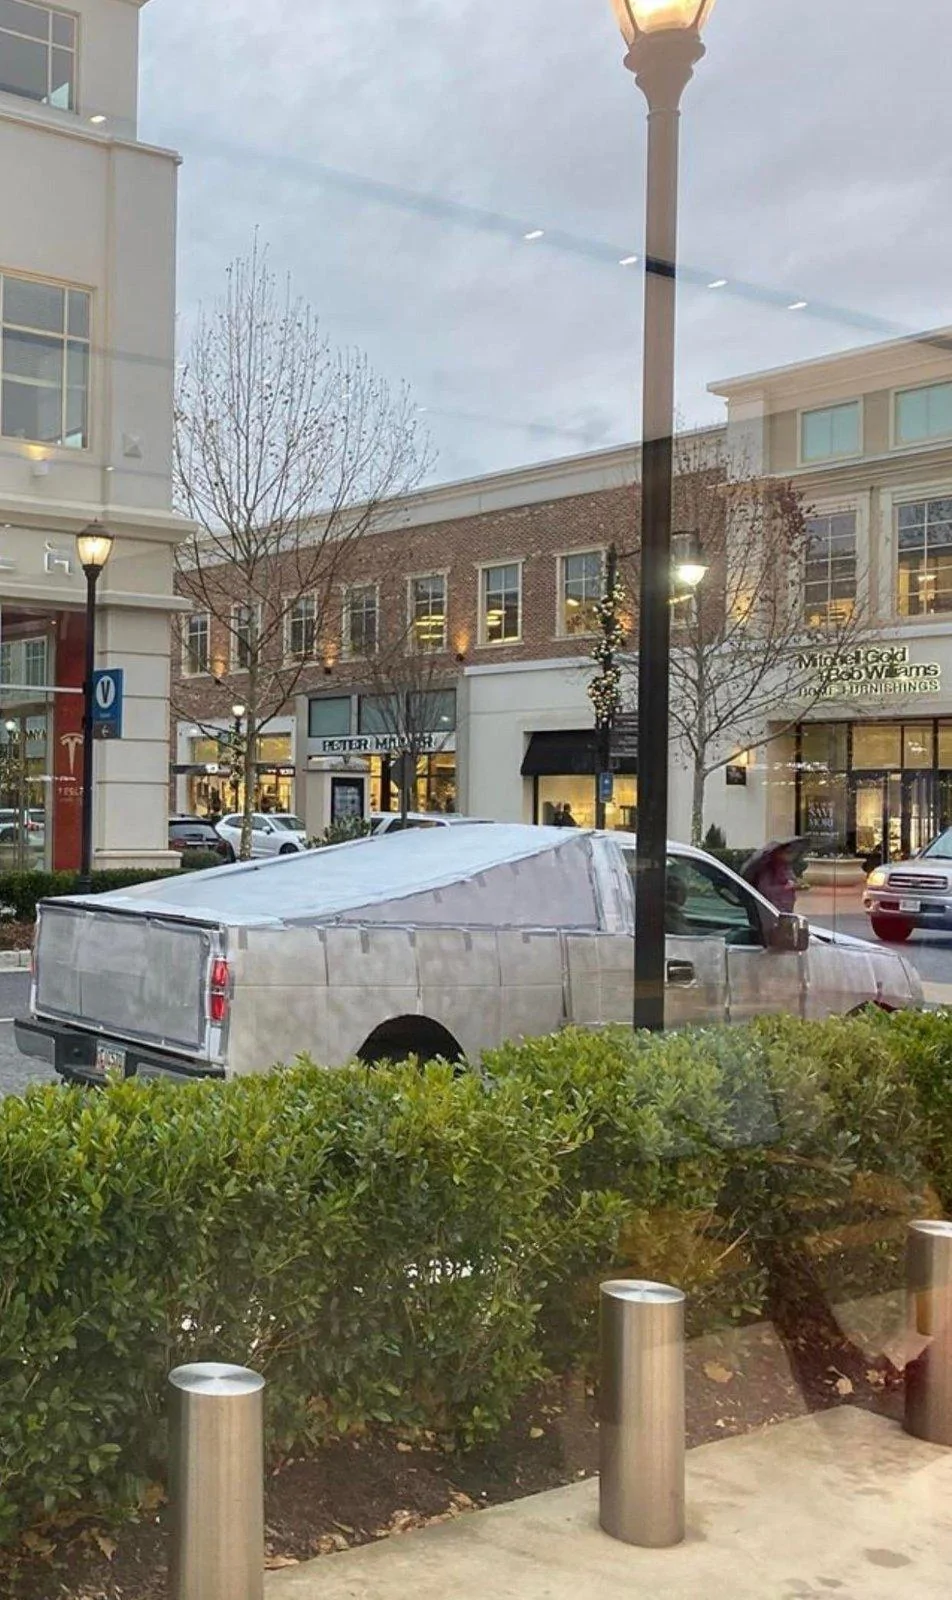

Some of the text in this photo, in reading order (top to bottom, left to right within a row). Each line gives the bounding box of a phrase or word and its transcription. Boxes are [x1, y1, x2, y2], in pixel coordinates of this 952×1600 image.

[865, 646, 907, 664] Gold
[864, 662, 940, 679] Williams
[101, 680, 110, 704] V
[842, 679, 940, 695] FURNISHINGS
[322, 738, 371, 752] PETER
